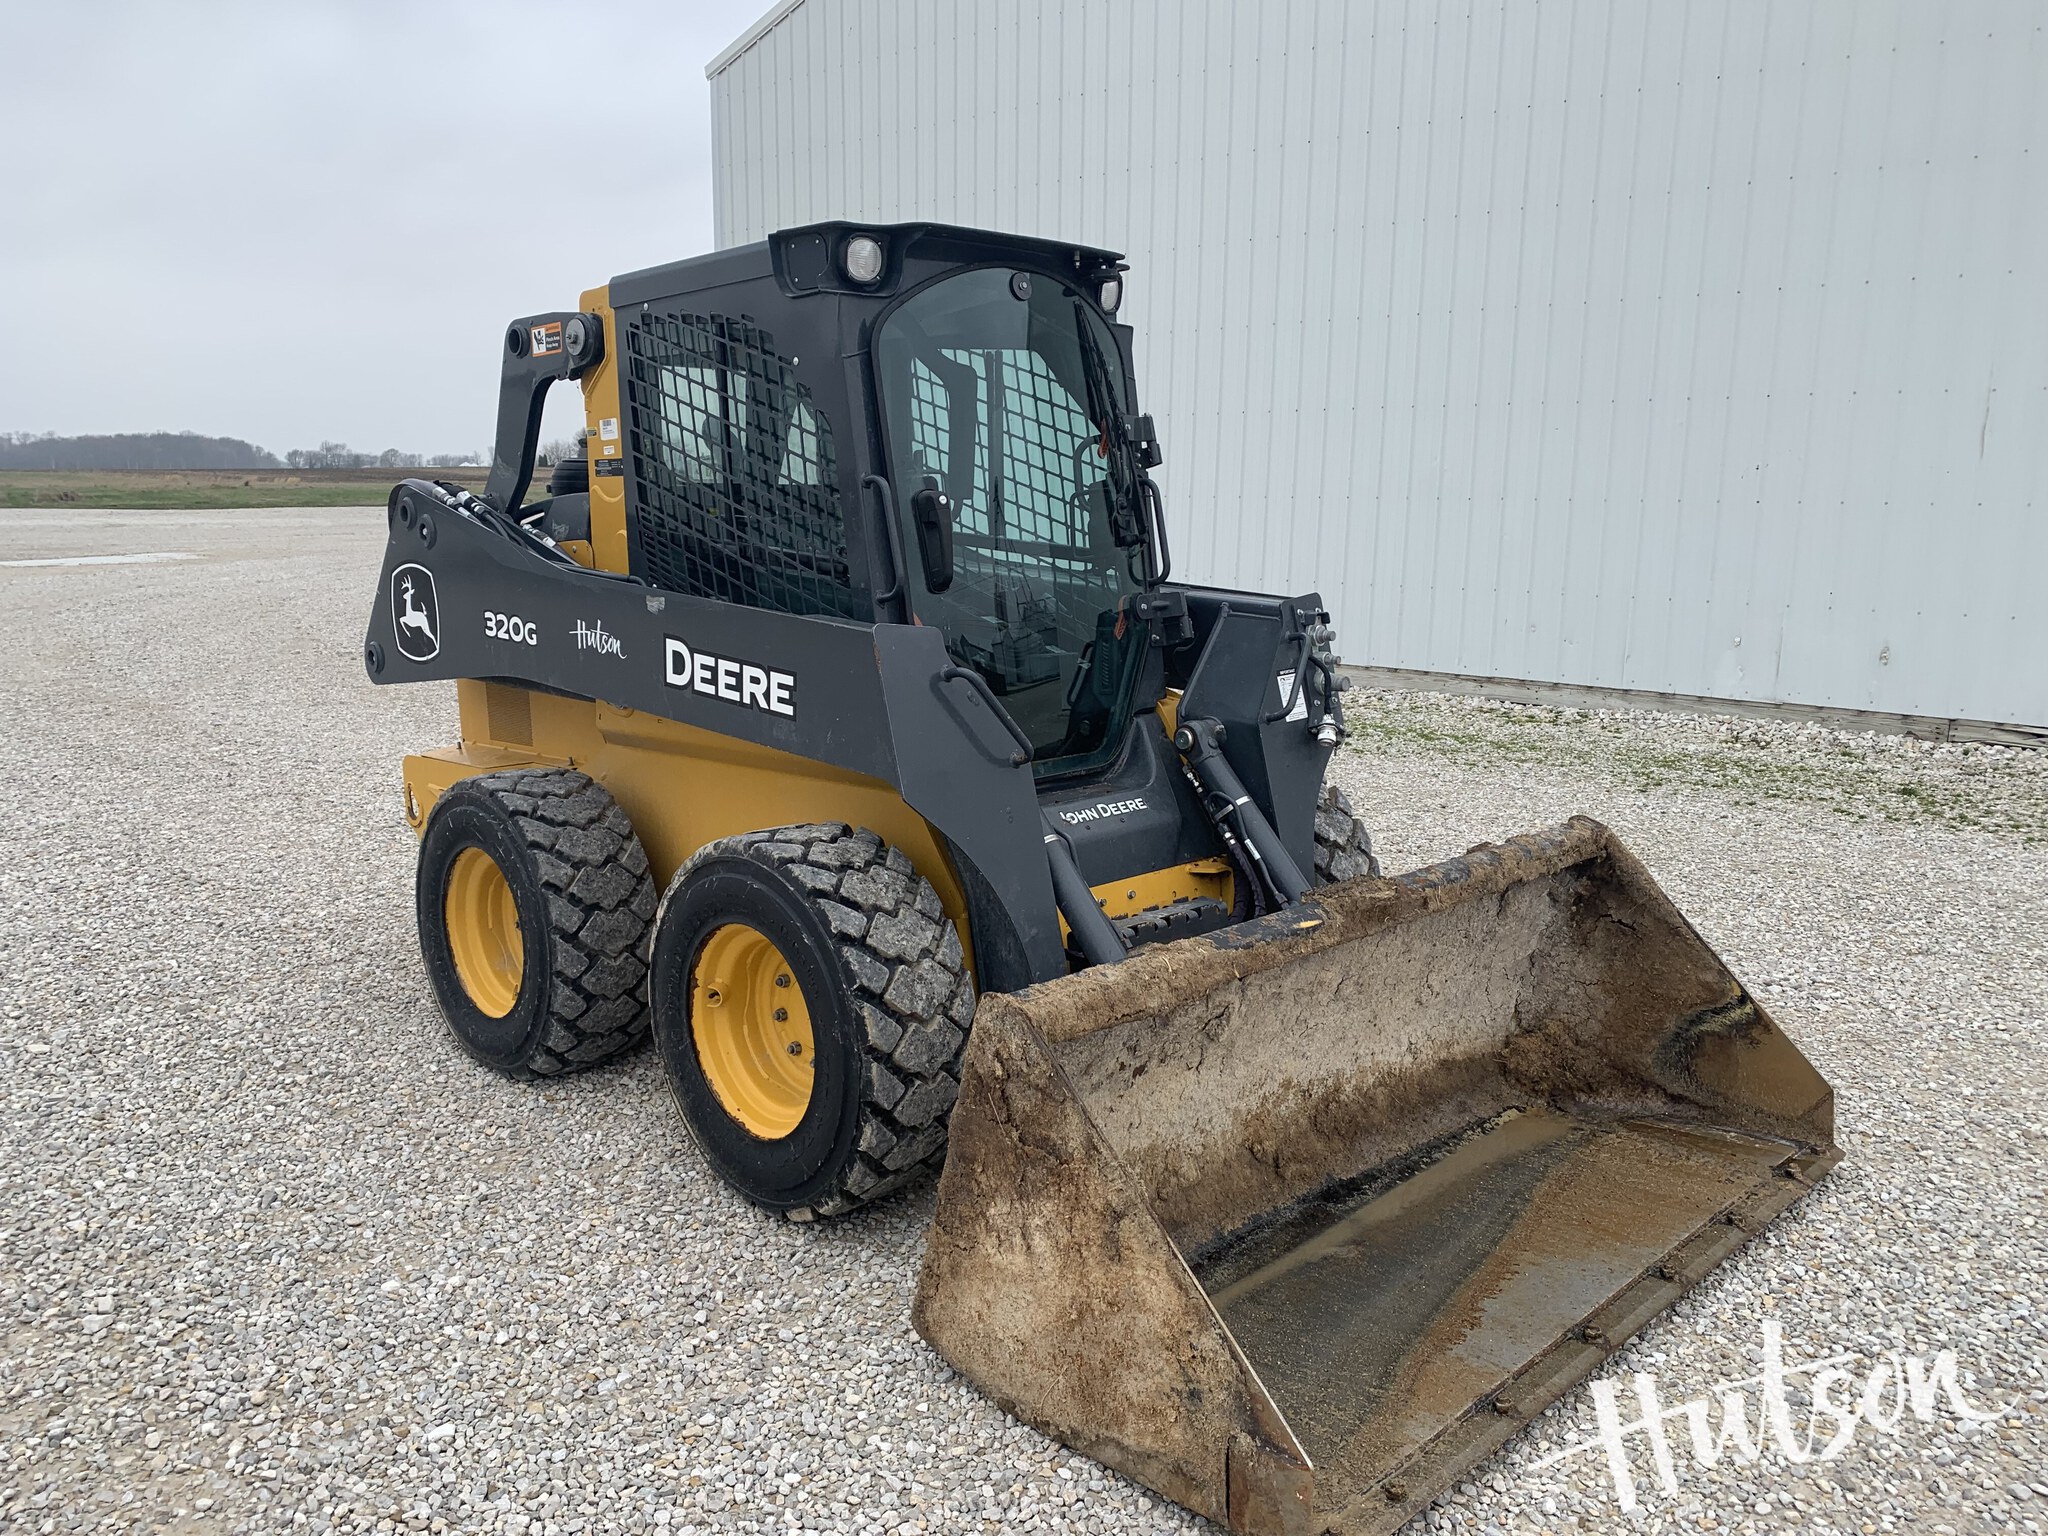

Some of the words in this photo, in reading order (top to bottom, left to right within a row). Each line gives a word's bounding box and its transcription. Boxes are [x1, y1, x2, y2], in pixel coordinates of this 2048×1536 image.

[484, 611, 537, 646] 320G
[569, 619, 628, 659] Hutson
[665, 637, 795, 716] DEERE
[1059, 807, 1099, 825] JOHN
[1096, 797, 1148, 818] DEERE
